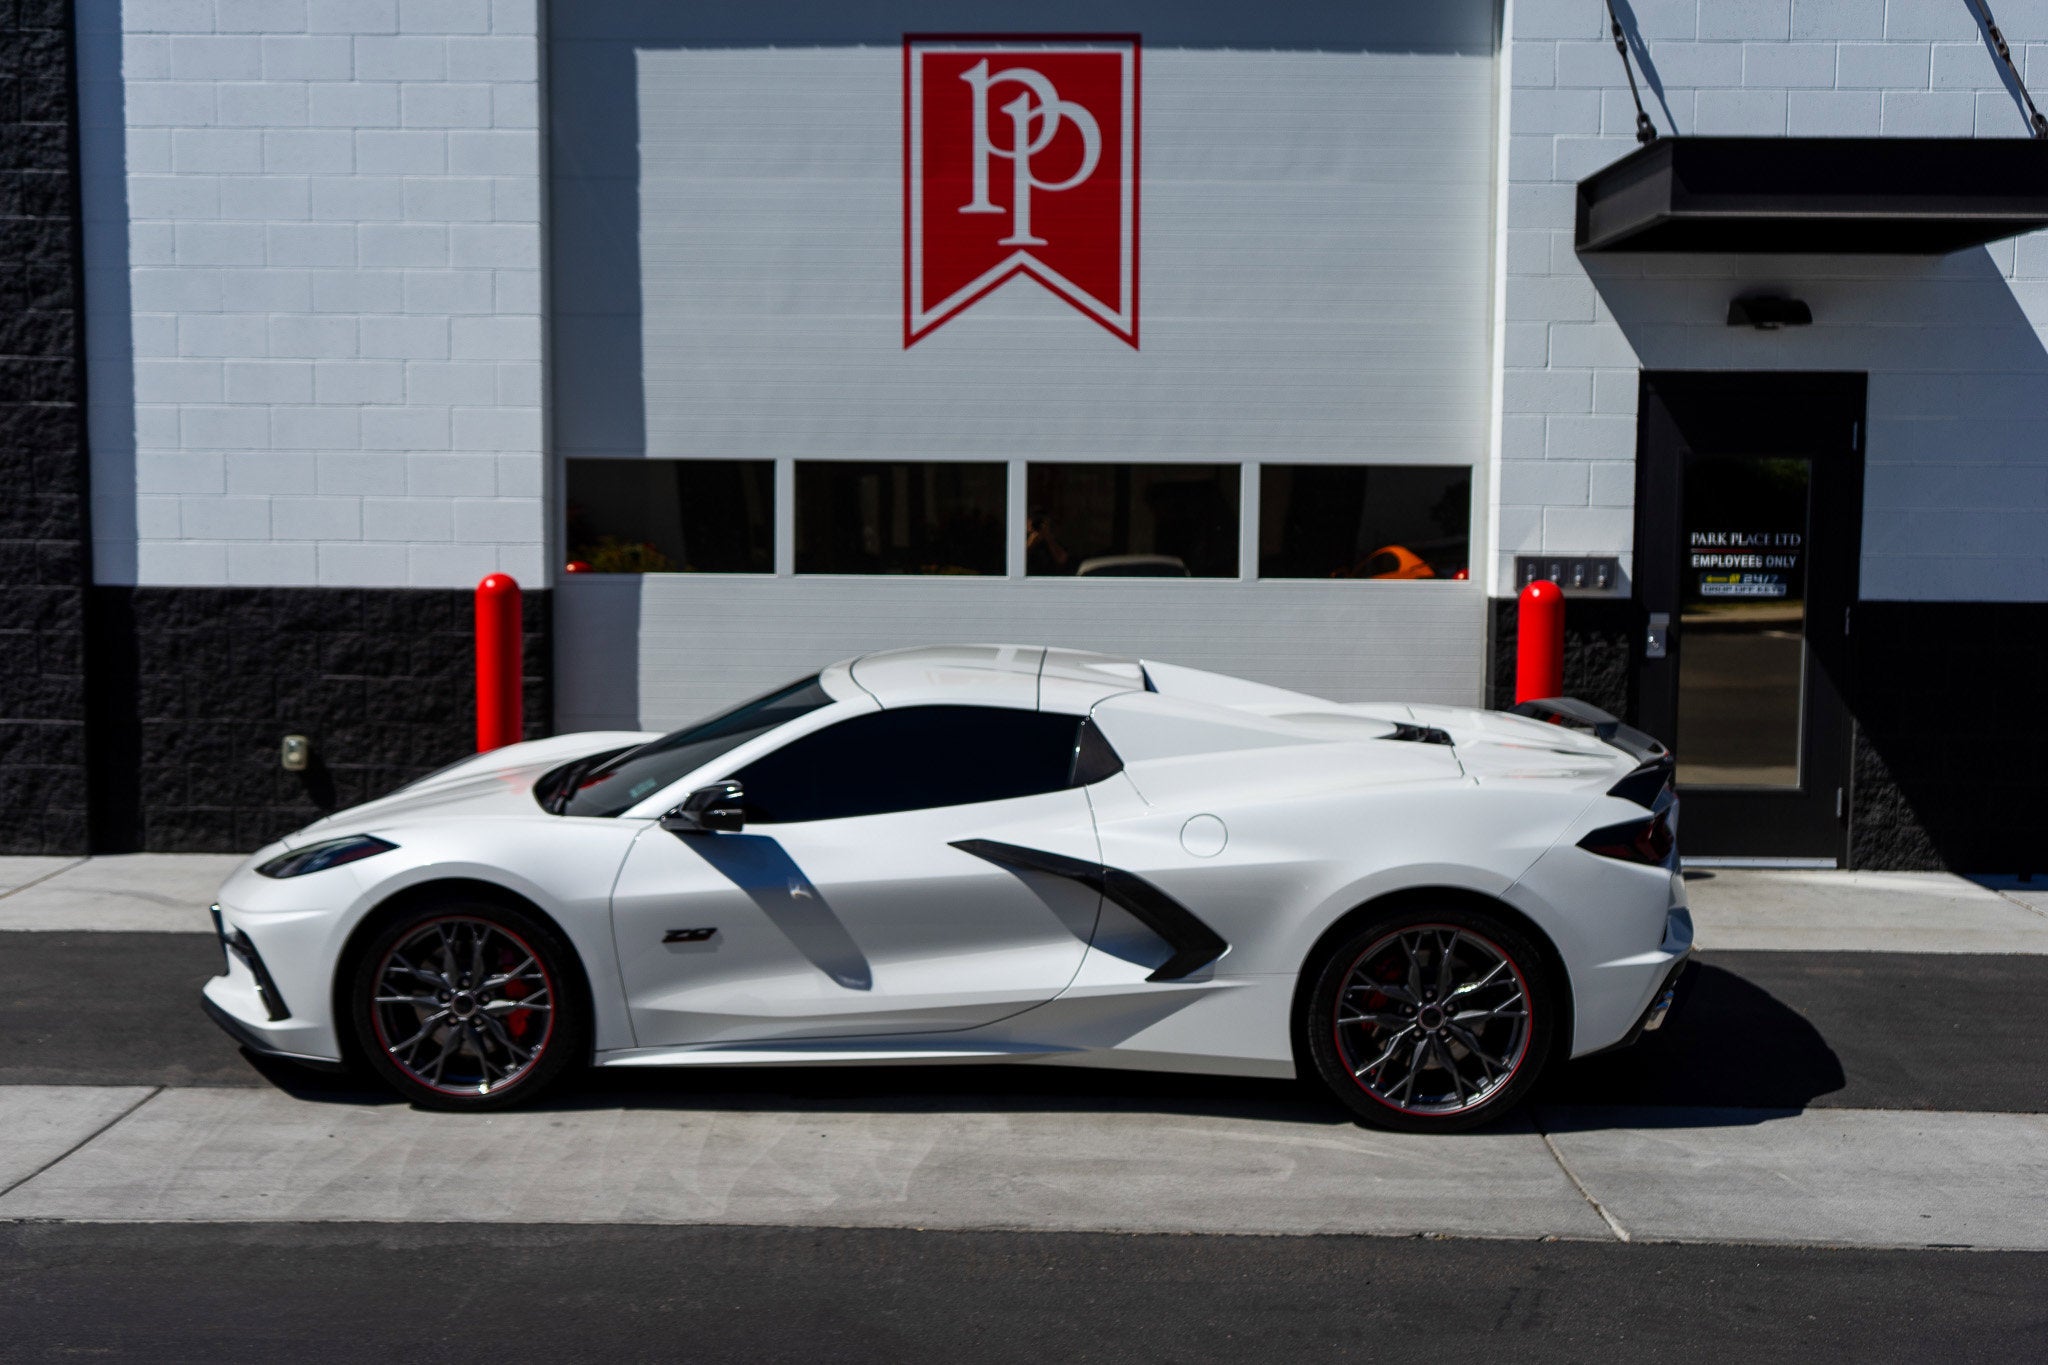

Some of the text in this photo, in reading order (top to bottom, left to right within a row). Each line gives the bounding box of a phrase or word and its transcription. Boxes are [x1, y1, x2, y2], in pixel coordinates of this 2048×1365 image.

[1691, 531, 1801, 546] PARK PLACE LTD
[1692, 554, 1797, 568] EMPLOYEES ONLY
